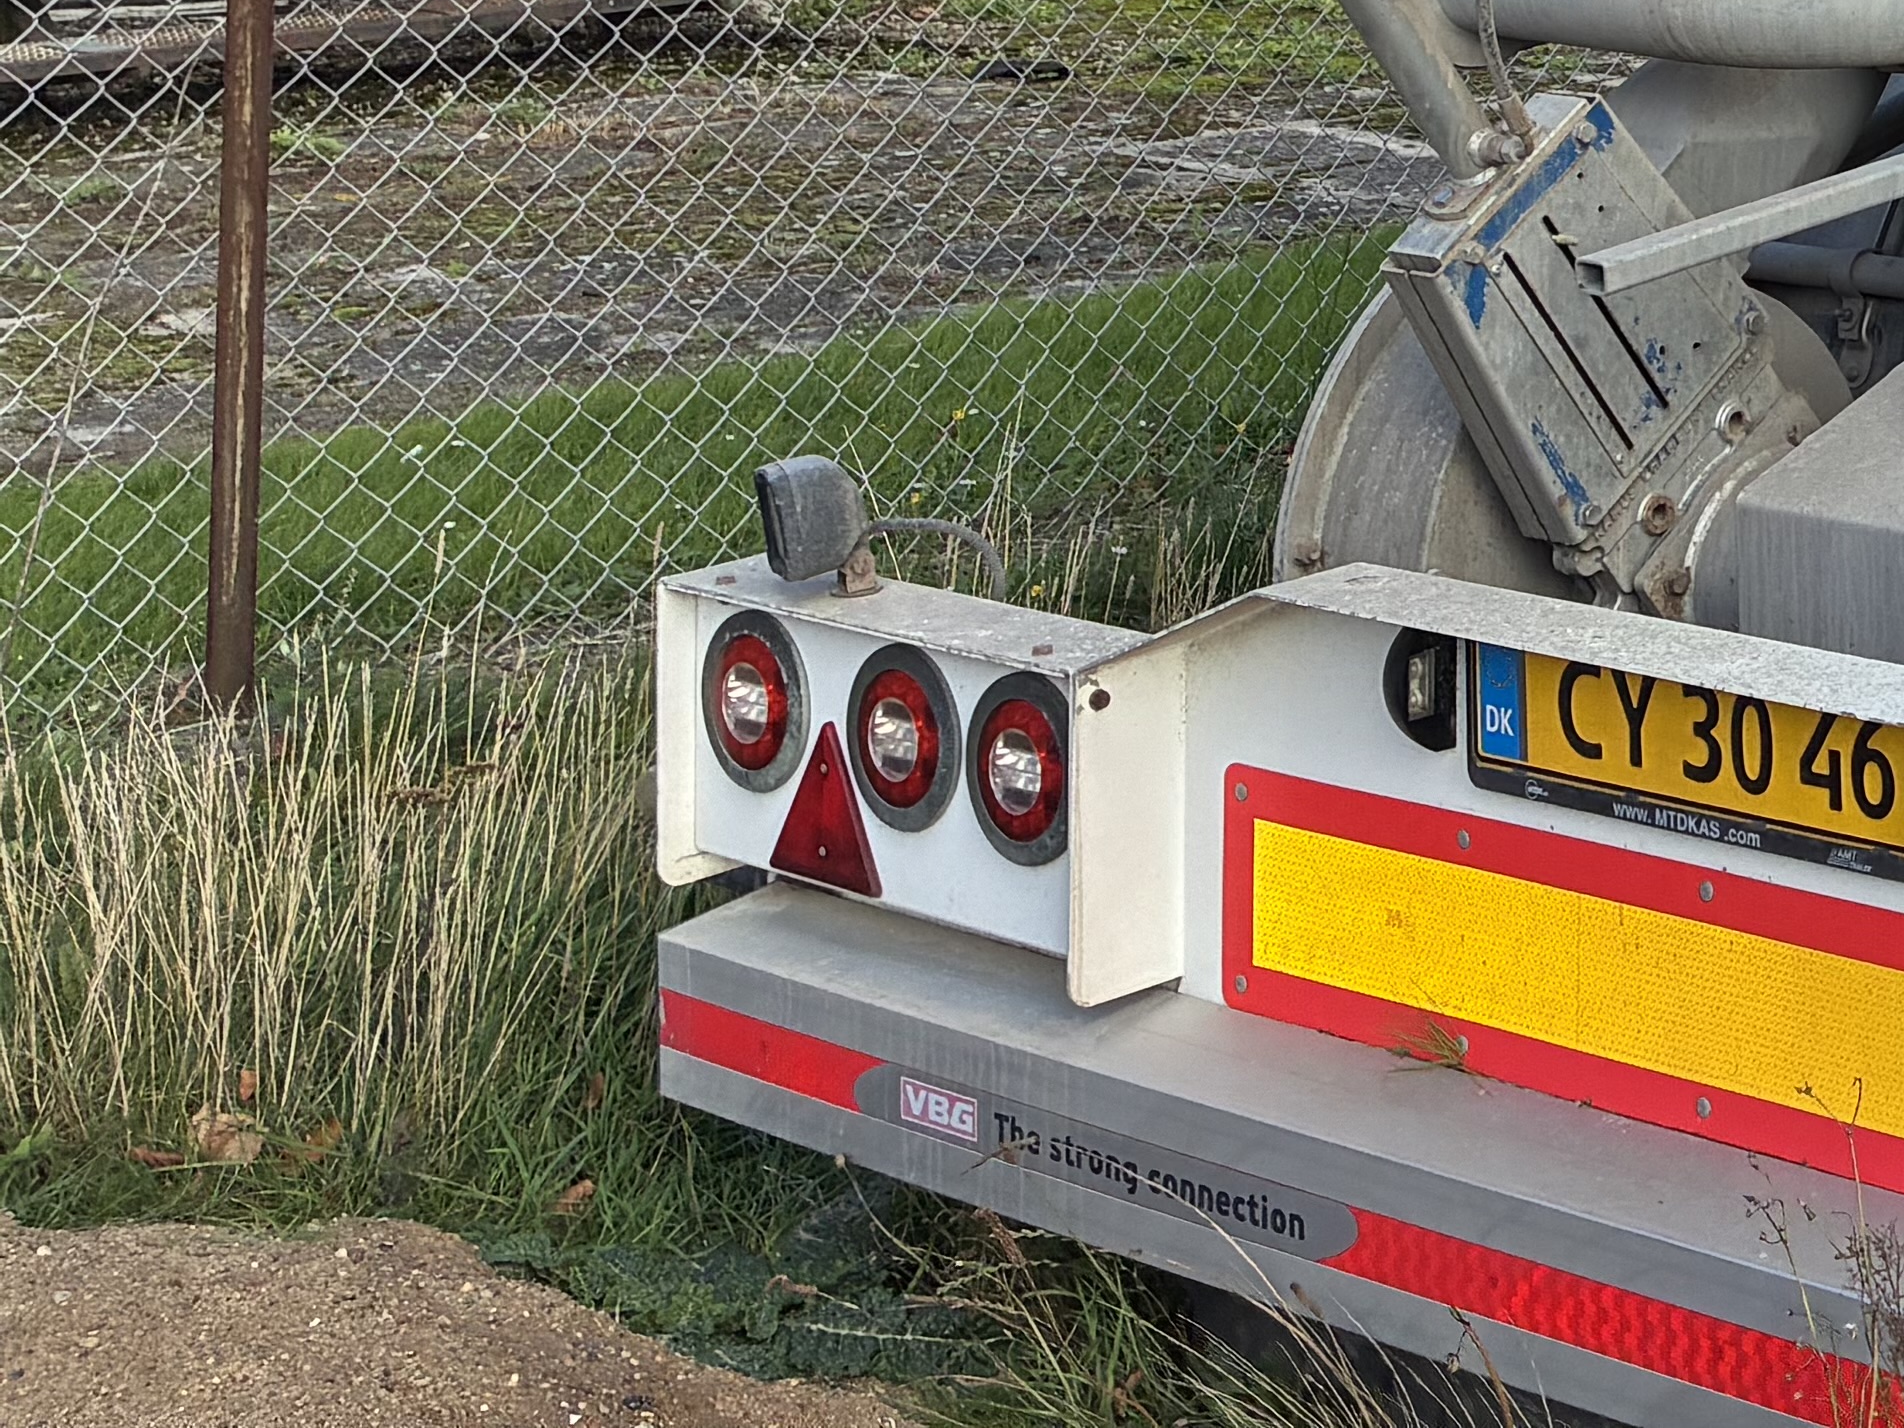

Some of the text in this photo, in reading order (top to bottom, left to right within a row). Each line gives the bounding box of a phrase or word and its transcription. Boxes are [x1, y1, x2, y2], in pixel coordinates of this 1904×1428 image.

[1486, 705, 1514, 736] DK
[1558, 660, 1895, 819] CY 30 46
[905, 1083, 975, 1133] VBG
[1049, 1134, 1139, 1194] strong
[1148, 1168, 1306, 1240] connection
